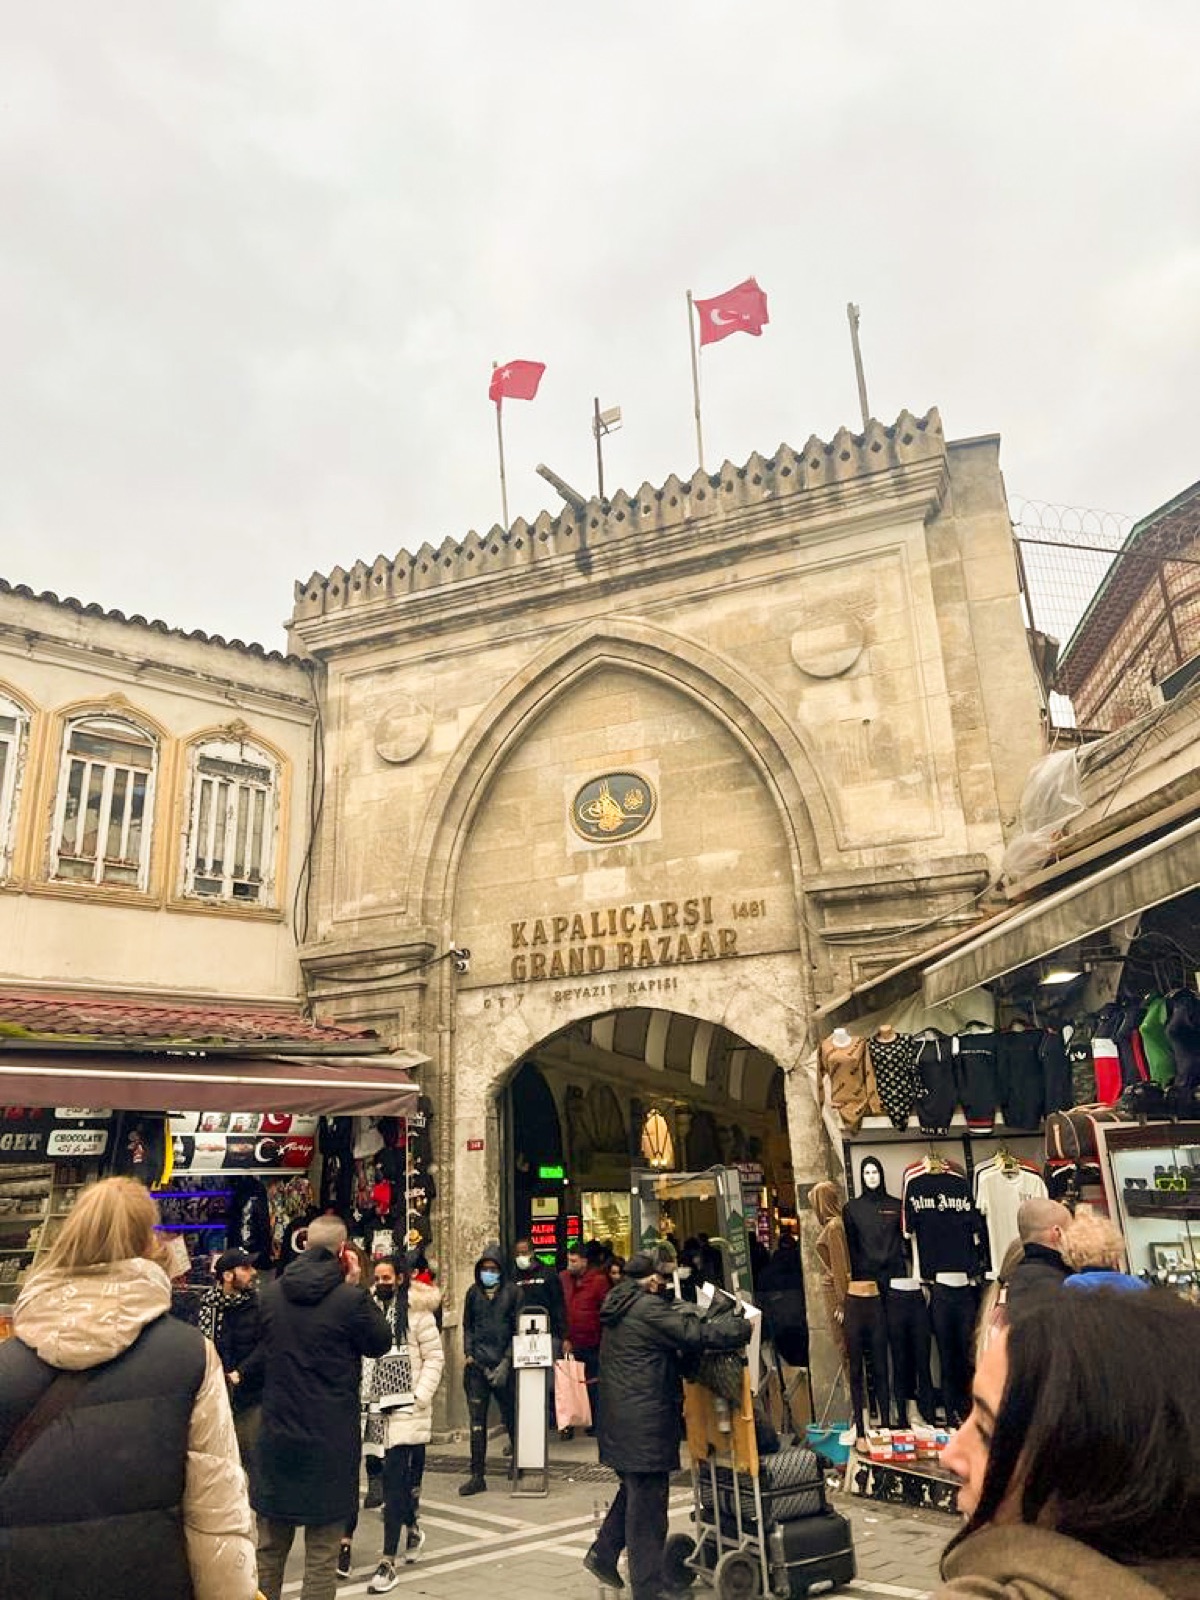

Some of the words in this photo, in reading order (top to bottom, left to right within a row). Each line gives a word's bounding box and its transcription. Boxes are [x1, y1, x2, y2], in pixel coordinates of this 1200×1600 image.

[510, 896, 714, 949] KAPALIÇARŞI
[731, 899, 767, 920] 1481
[510, 944, 606, 982] GRAND
[617, 927, 739, 969] BAZAAR
